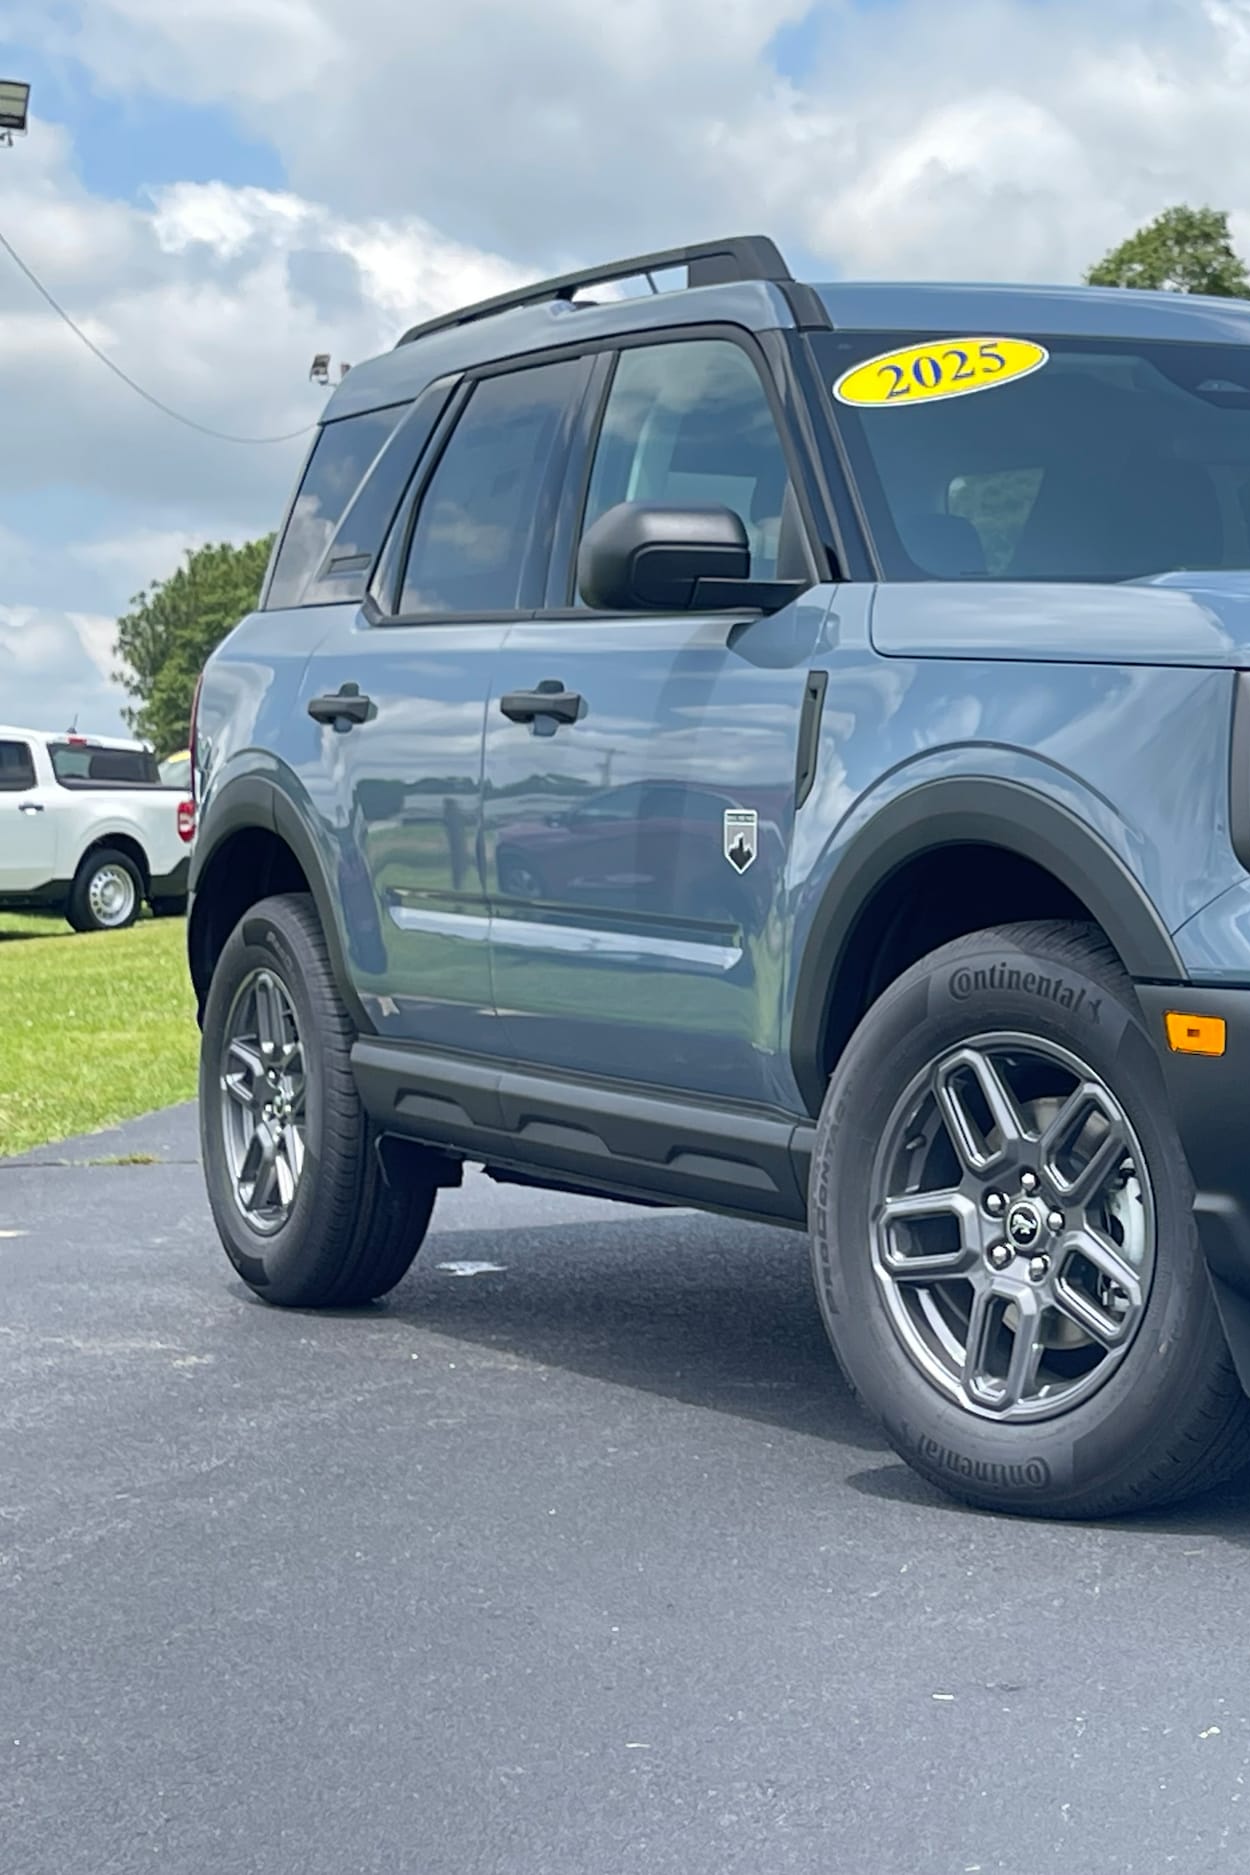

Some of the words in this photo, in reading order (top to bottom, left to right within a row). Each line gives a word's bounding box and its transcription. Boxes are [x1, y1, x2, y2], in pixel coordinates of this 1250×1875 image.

[876, 342, 1006, 400] 2025
[949, 961, 1087, 1014] Continental
[917, 1433, 1051, 1491] Continental
